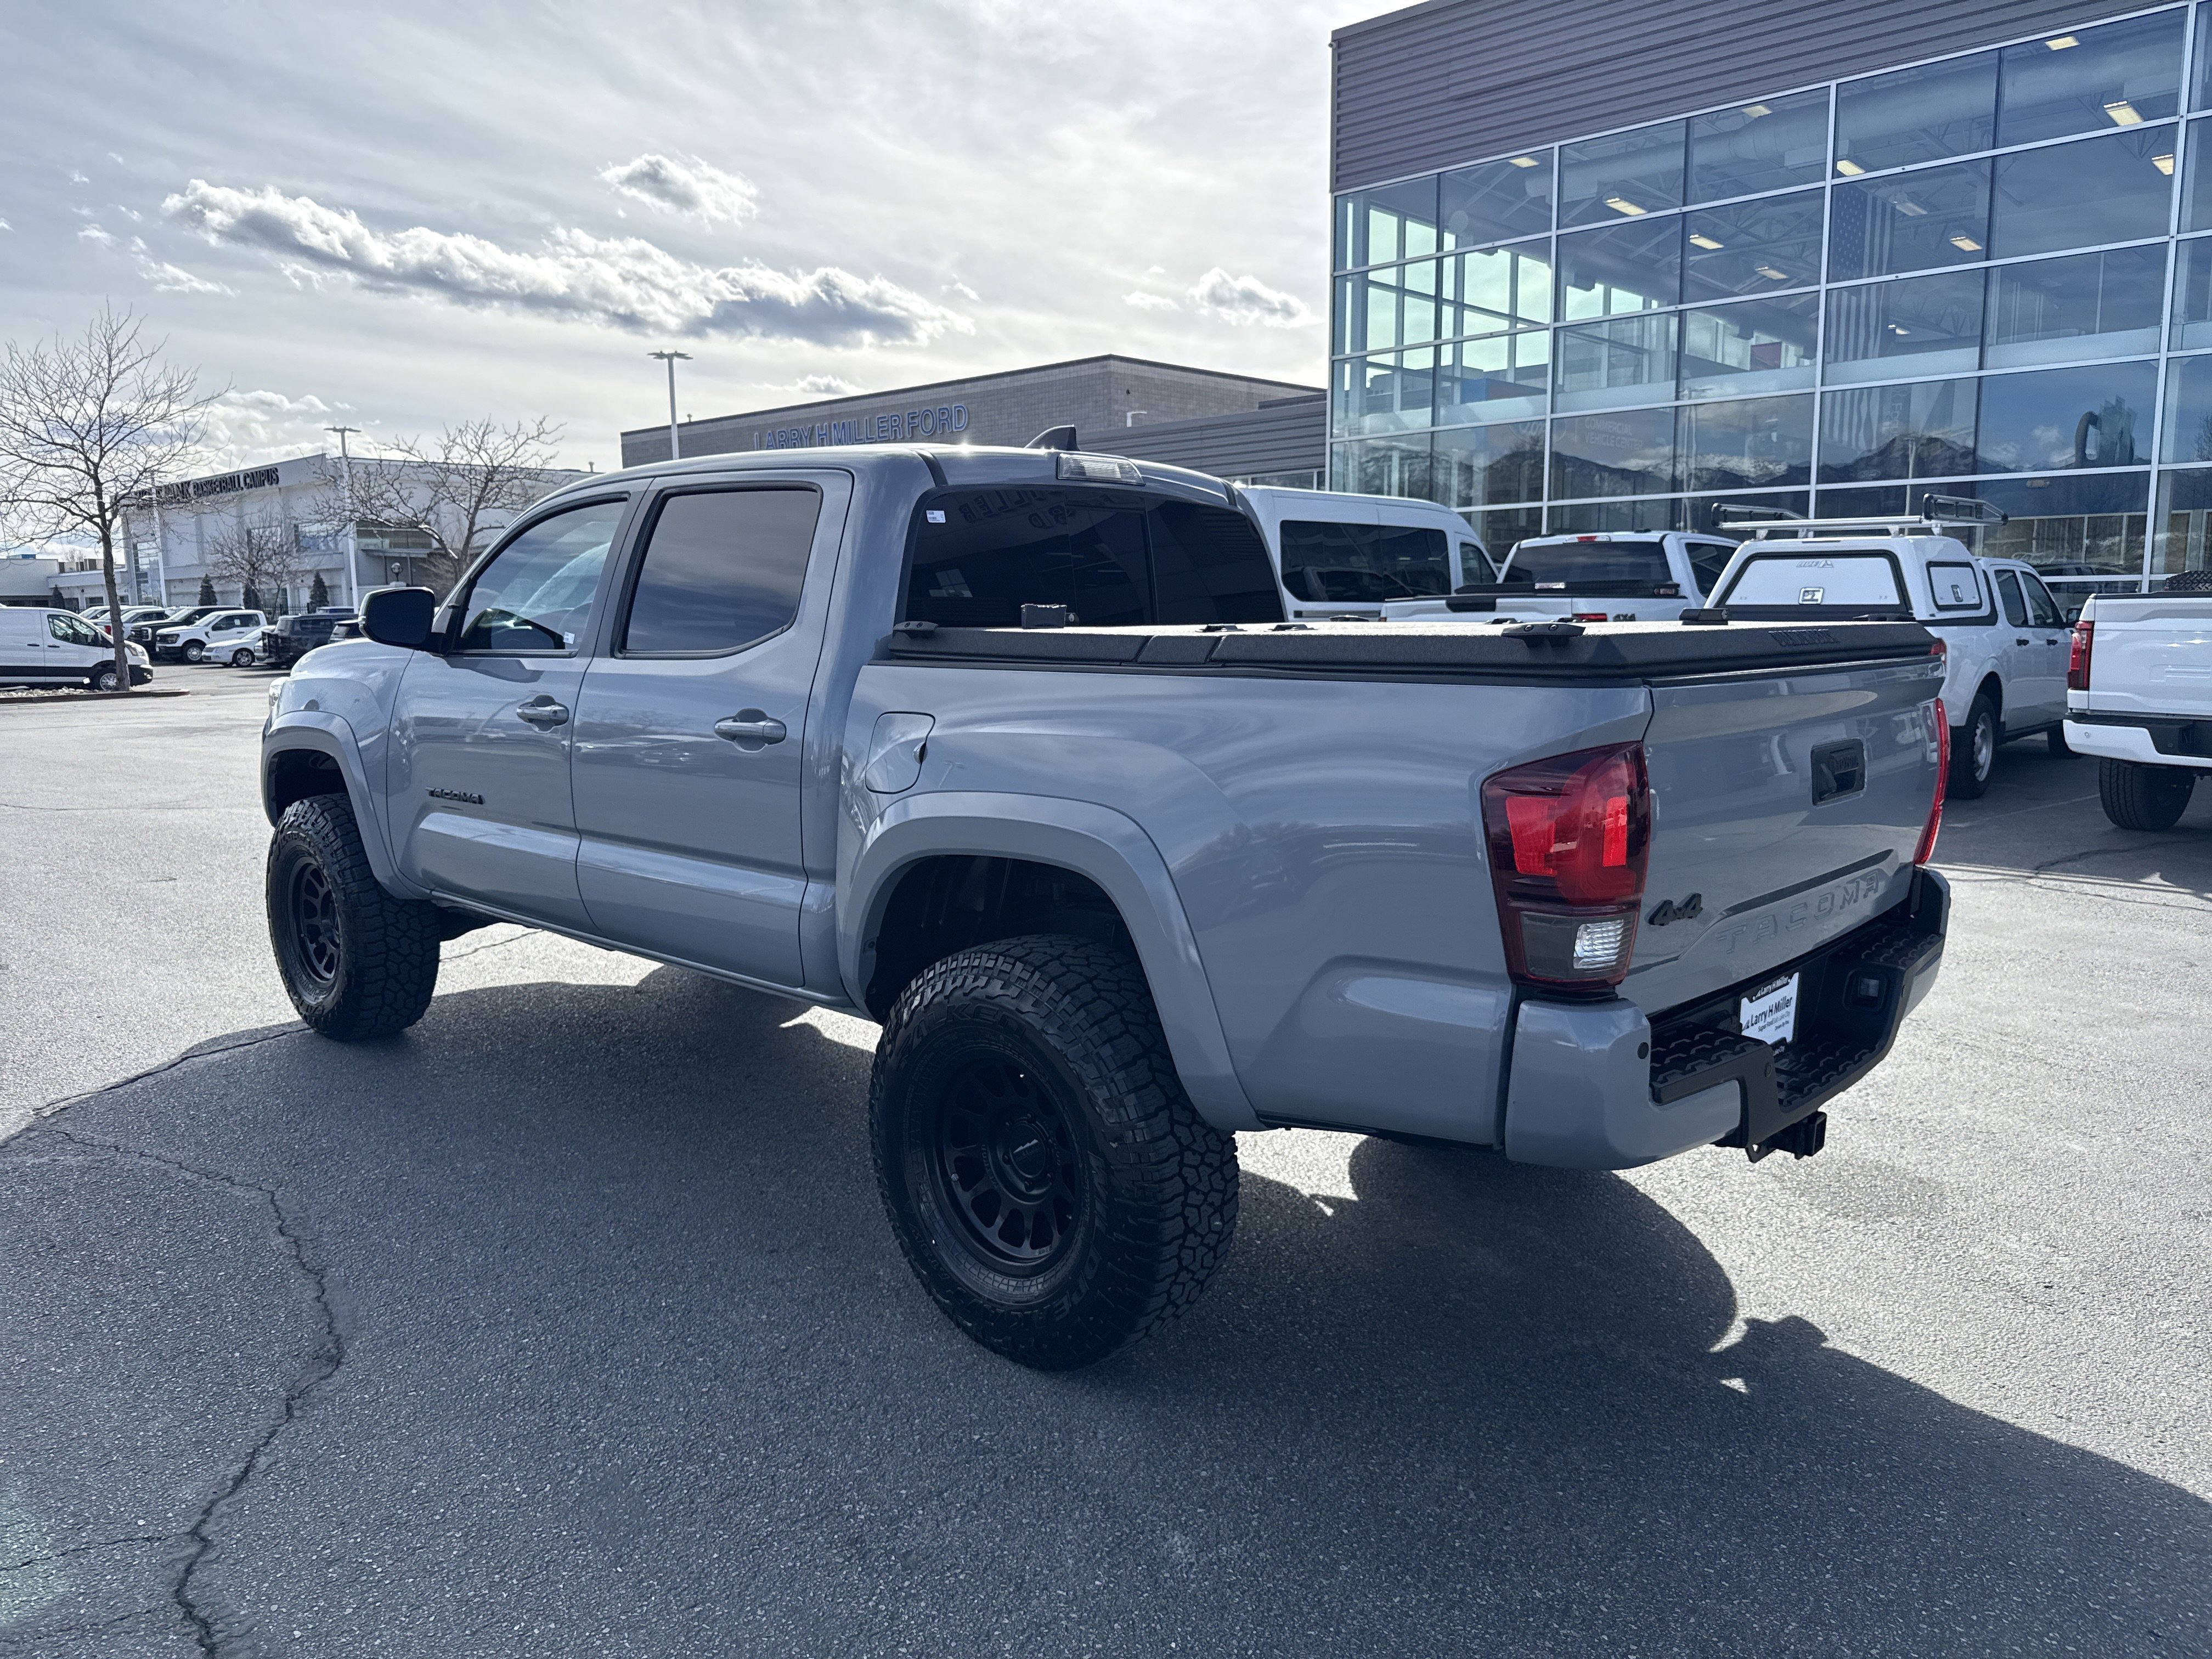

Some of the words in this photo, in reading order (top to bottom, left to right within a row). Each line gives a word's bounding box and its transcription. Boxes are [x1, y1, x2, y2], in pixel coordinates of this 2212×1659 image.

[754, 425, 812, 450] LARRY
[816, 424, 828, 447] H
[832, 413, 903, 445] MILLER
[906, 404, 969, 438] FORD
[243, 467, 280, 489] CAMPUS
[1716, 869, 1880, 955] TACOMA
[1751, 1009, 1768, 1026] Larry
[1768, 1003, 1774, 1017] H
[1774, 996, 1792, 1014] Miller
